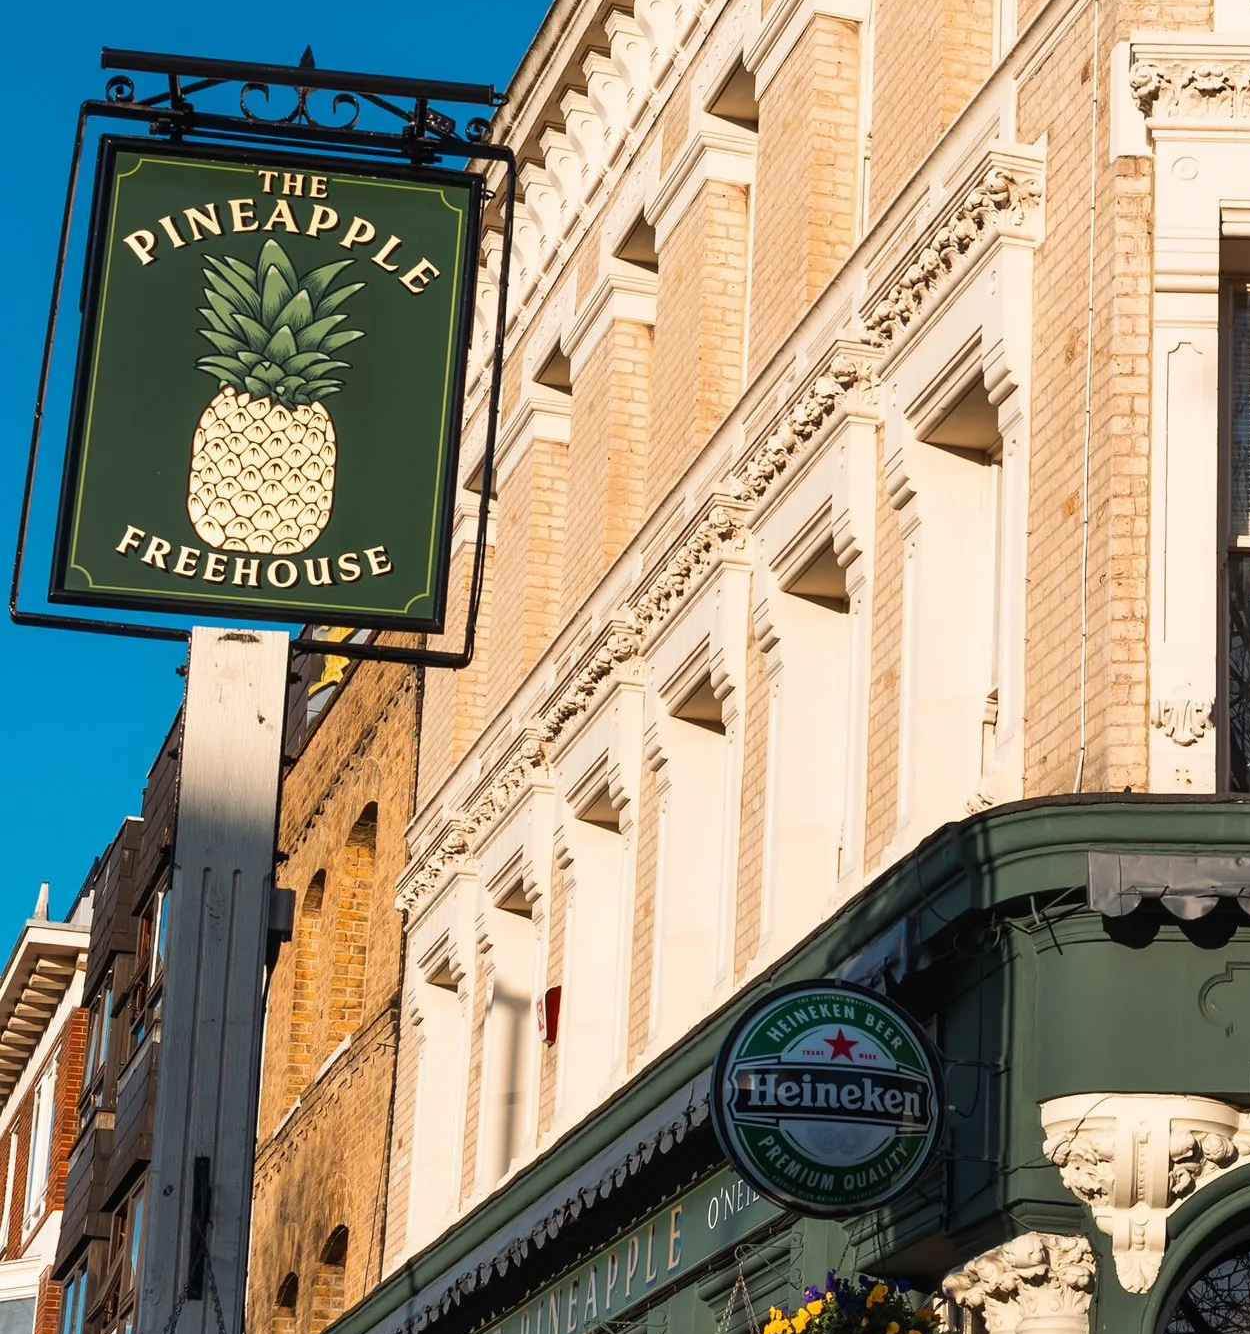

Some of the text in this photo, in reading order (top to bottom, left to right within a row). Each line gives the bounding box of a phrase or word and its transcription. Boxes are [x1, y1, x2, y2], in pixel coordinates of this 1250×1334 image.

[257, 169, 329, 199] THE
[122, 197, 441, 296] PINEAPPLE
[115, 524, 395, 589] FREEHOUSE
[766, 1003, 903, 1051] HEINEKEN BEER
[748, 1073, 921, 1116] Heineken
[757, 1135, 908, 1191] PREMIUM QUALITY
